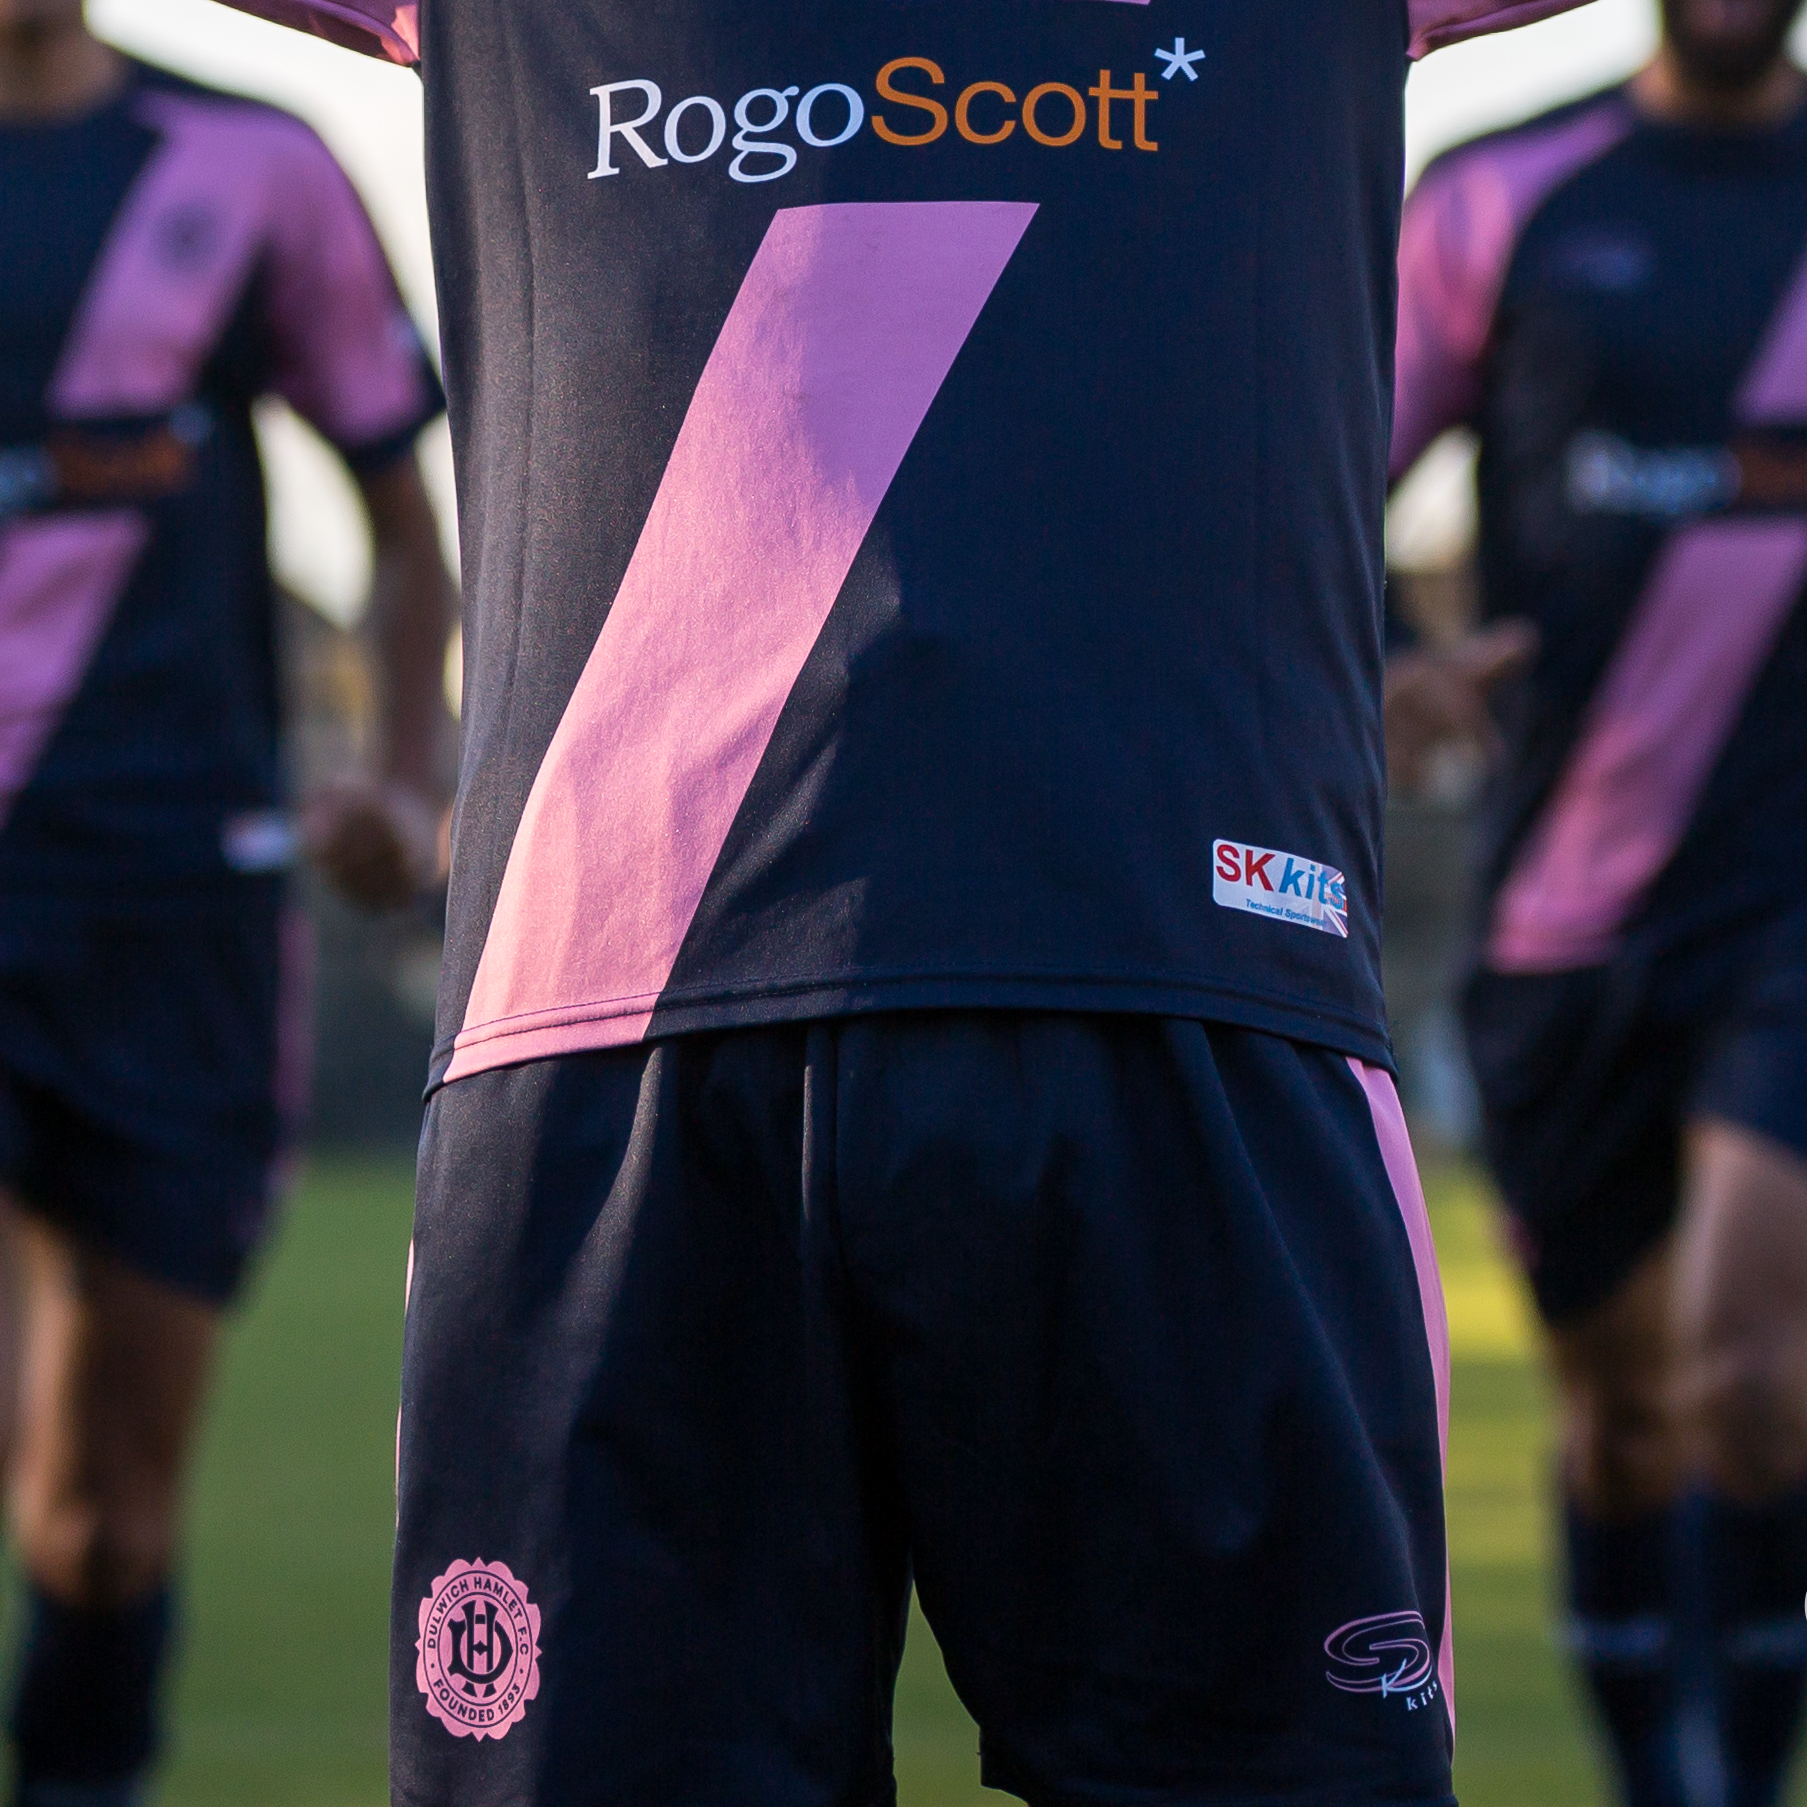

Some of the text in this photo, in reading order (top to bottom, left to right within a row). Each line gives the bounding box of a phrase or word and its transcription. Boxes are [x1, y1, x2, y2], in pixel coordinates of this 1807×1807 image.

[1246, 898, 1284, 916] Technical
[427, 1578, 469, 1649] DULWICH
[474, 1576, 523, 1619] HAMLET
[433, 1678, 520, 1722] FOUNDED 1893
